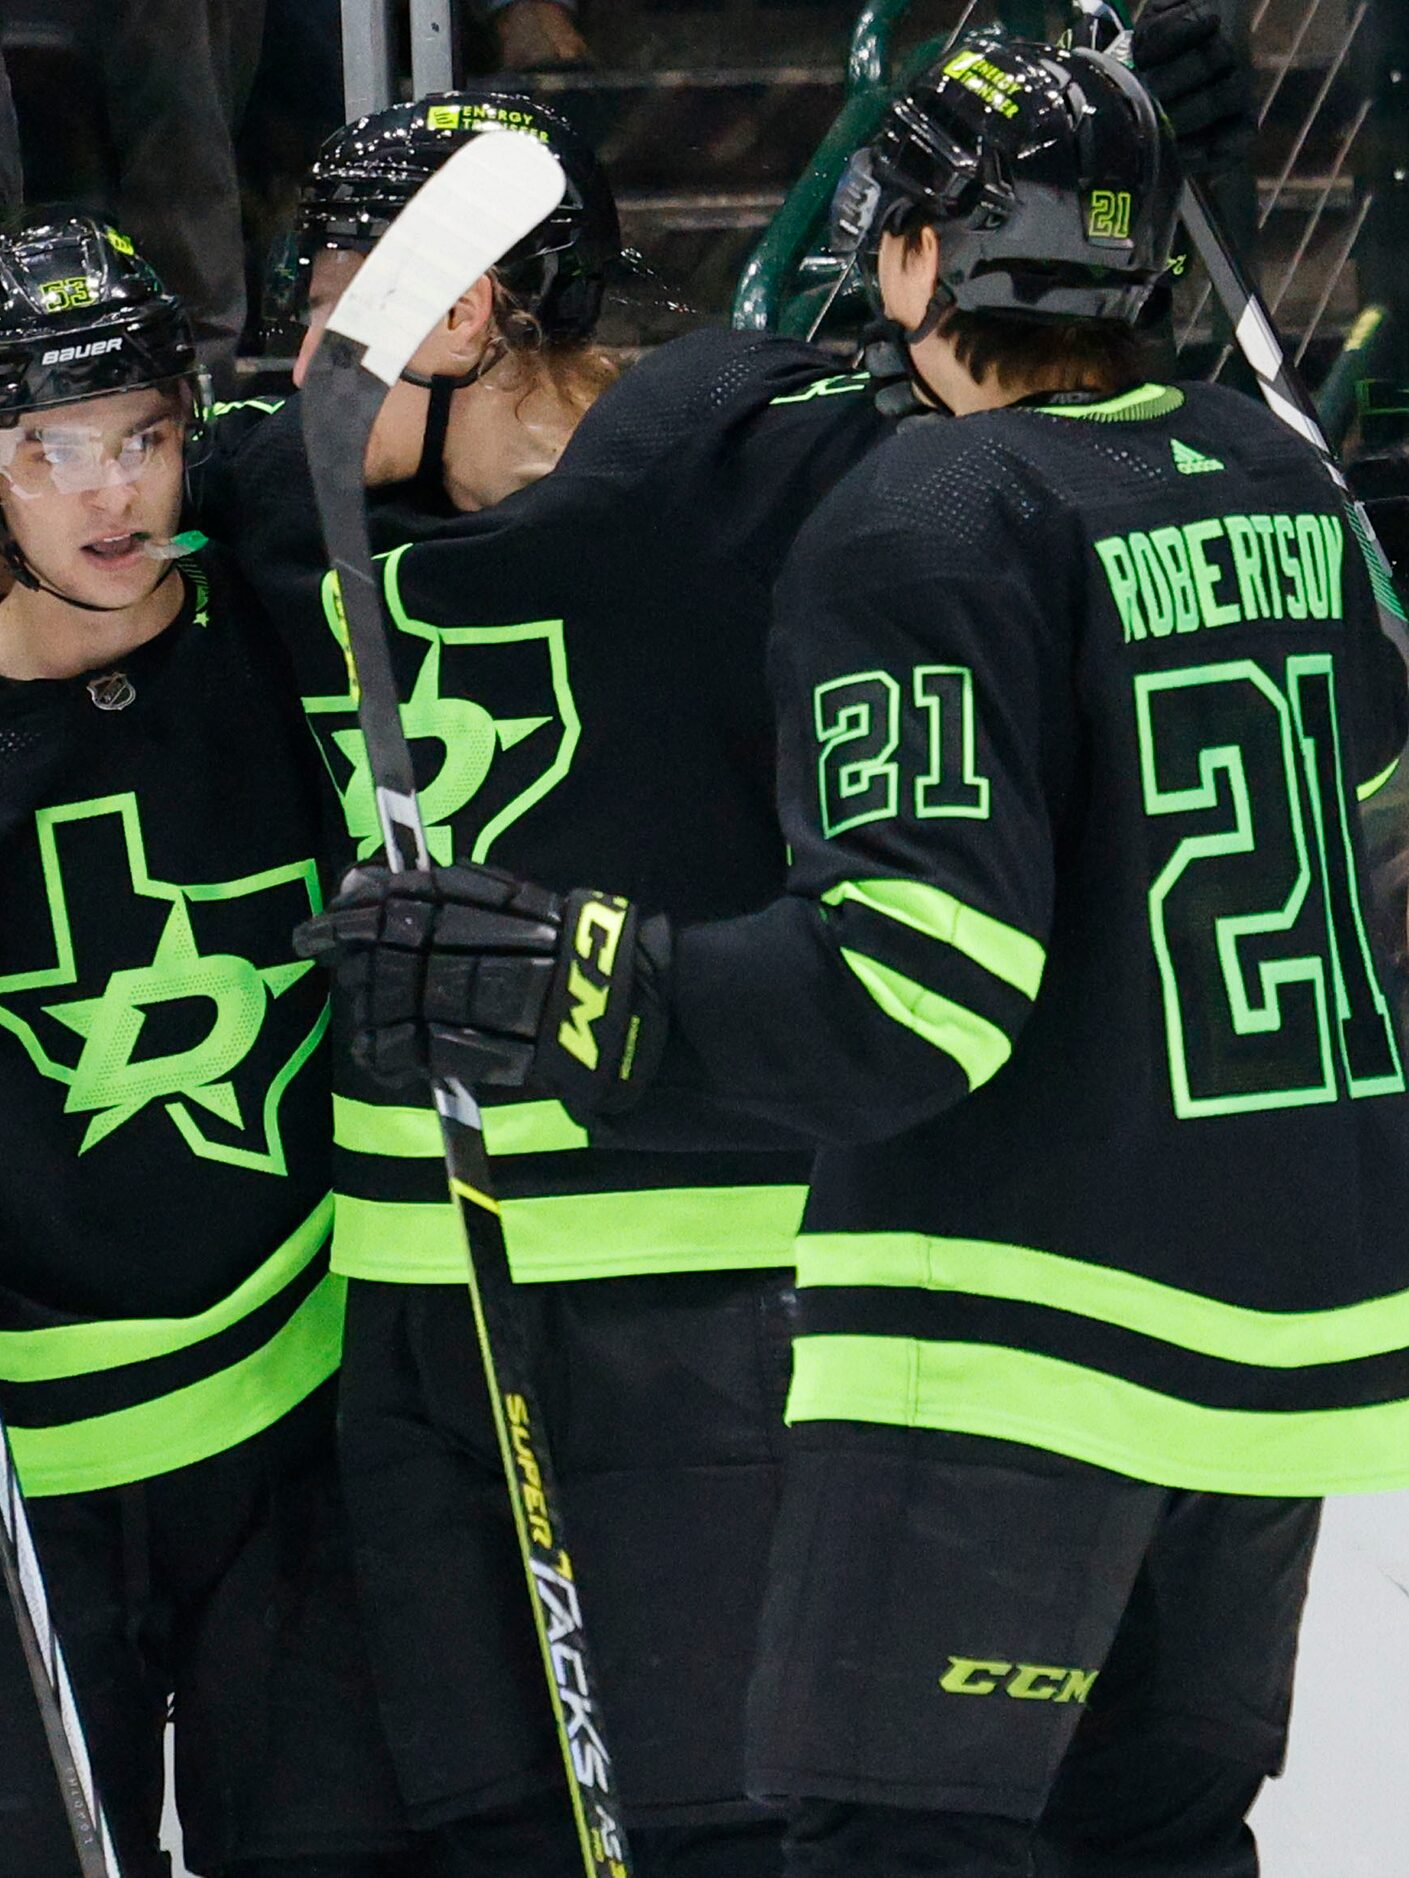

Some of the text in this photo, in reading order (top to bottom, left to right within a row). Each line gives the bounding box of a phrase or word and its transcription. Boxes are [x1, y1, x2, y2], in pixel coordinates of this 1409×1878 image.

[463, 106, 533, 125] ENERGY
[1089, 190, 1131, 238] 21
[40, 276, 99, 313] 53
[42, 337, 124, 366] BAUER
[1095, 515, 1344, 644] ROBERTSON
[815, 665, 989, 839] 21
[1135, 654, 1406, 1120] 21
[558, 890, 630, 1072] CM
[505, 1393, 553, 1549] SUPER
[529, 1549, 610, 1794] TACKS
[938, 1656, 1100, 1703] CCM
